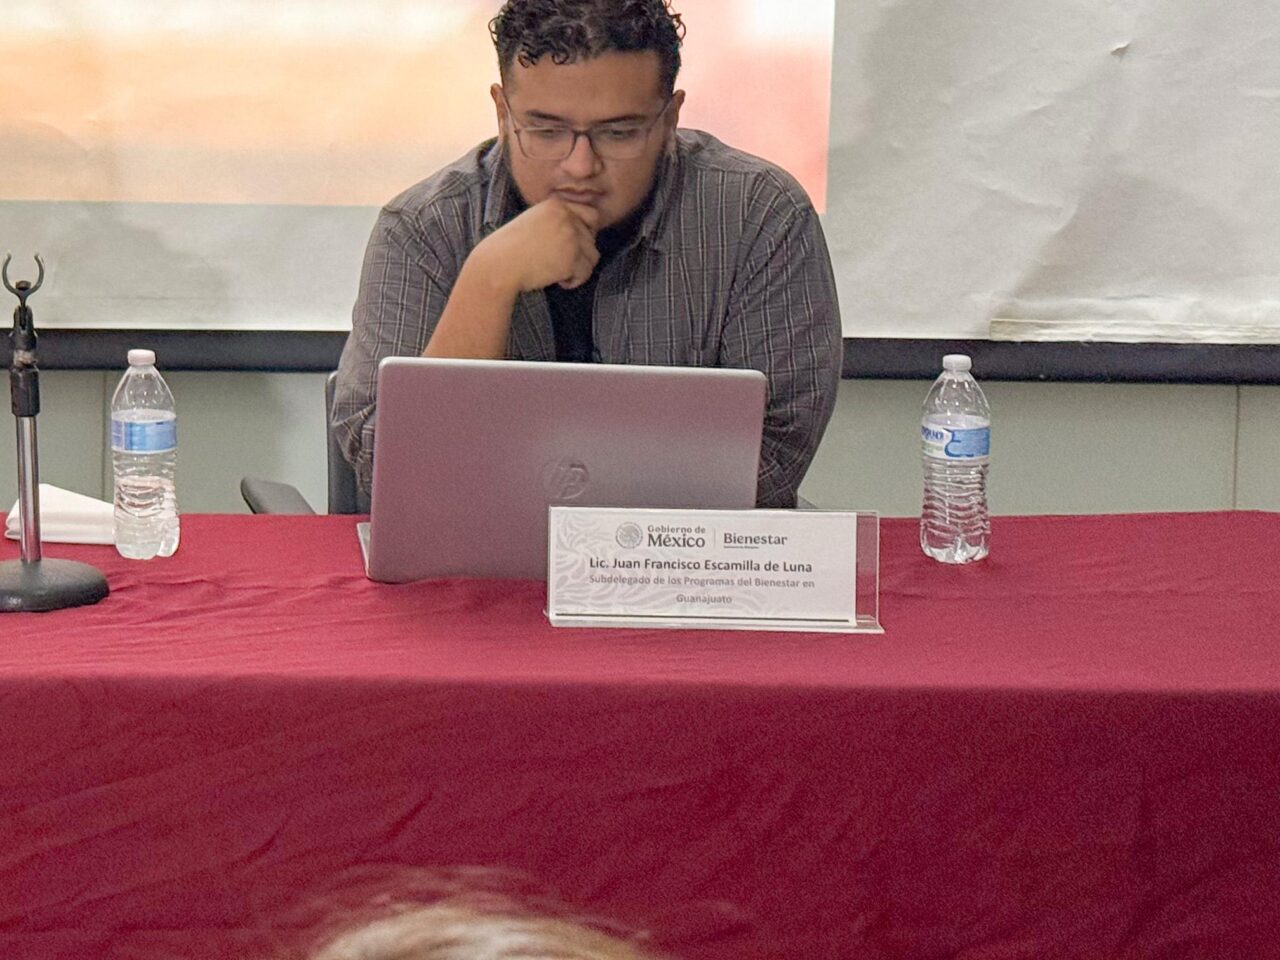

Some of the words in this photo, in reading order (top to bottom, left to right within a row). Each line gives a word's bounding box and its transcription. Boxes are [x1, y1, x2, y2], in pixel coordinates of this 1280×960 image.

[647, 525, 693, 534] Gobierno
[695, 526, 706, 534] de
[647, 534, 706, 548] México
[723, 532, 788, 546] Bienestar
[589, 557, 609, 570] Lic.
[613, 558, 641, 570] Juan
[644, 559, 701, 572] Francisco
[704, 559, 760, 573] Escamilla
[764, 560, 780, 573] de
[783, 561, 813, 573] Luna
[589, 574, 651, 587] Subdelegado
[653, 576, 665, 586] de
[668, 575, 681, 586] los
[684, 576, 735, 589] Programas
[737, 577, 752, 588] del
[754, 578, 800, 589] Bienestar
[802, 581, 815, 589] en
[676, 593, 732, 606] Guanajuato
